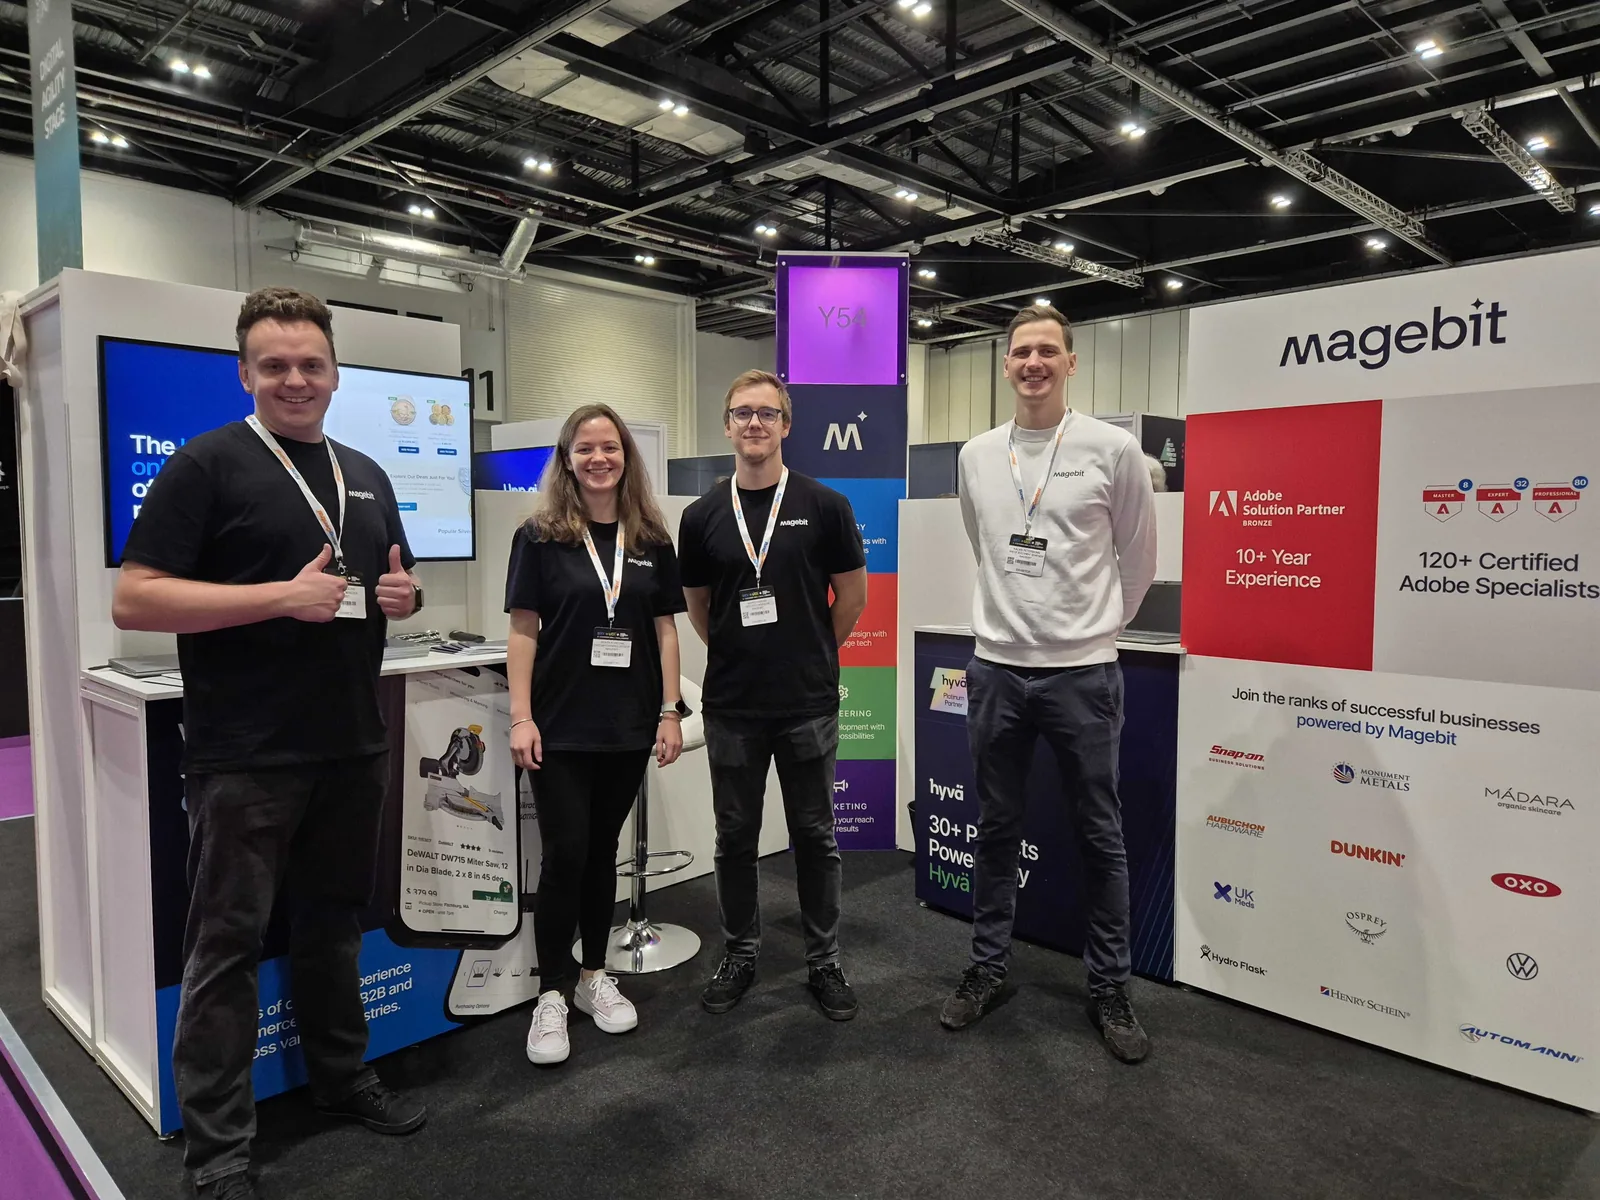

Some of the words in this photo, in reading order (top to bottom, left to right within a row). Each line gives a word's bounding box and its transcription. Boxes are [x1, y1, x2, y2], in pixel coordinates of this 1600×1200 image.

[42, 67, 65, 112] AGILITY
[44, 102, 65, 139] STAGE
[818, 306, 868, 329] Y54
[129, 434, 176, 456] The
[1243, 490, 1283, 502] Adobe
[1243, 504, 1293, 516] Solution
[1297, 504, 1345, 515] Partner
[1236, 548, 1267, 564] 10+
[1271, 549, 1312, 565] Year
[1419, 551, 1472, 569] 120+
[1479, 552, 1579, 572] Certified
[1225, 569, 1322, 589] Experience
[1399, 575, 1469, 594] Adobe
[1475, 577, 1600, 599] Specialists
[856, 639, 872, 647] tech
[872, 630, 888, 638] with
[942, 674, 967, 690] hyvä
[943, 692, 965, 701] Platinum
[944, 700, 964, 708] Partner
[838, 709, 872, 717] EERING
[1232, 687, 1260, 702] Join
[1262, 691, 1286, 705] the
[1288, 696, 1328, 710] ranks
[1331, 699, 1348, 712] of
[1350, 702, 1435, 723] successful
[1440, 710, 1541, 734] businesses
[838, 732, 875, 740] ossibilities
[870, 723, 885, 731] with
[1297, 715, 1361, 733] powered
[1365, 721, 1385, 739] by
[1388, 724, 1457, 745] Magebit
[1209, 744, 1265, 762] Snap-on
[1209, 757, 1234, 765] BUSINESS
[1235, 761, 1265, 771] SOLUTIONS
[1360, 768, 1410, 781] MONUMENT
[929, 778, 964, 801] hyvä
[1360, 777, 1410, 792] METALS
[833, 802, 868, 810] KETING
[1485, 787, 1575, 810] MÁDARA
[1497, 801, 1527, 810] organic
[1528, 805, 1562, 816] skincare
[836, 825, 859, 833] results
[854, 816, 875, 824] reach
[929, 814, 961, 837] 30+
[1206, 814, 1265, 832] AUBUCHON
[1206, 821, 1264, 839] HARDWARE
[407, 848, 439, 860] DeWALT
[441, 853, 466, 864] DW715
[467, 857, 484, 867] Miter
[485, 859, 501, 869] Saw,
[501, 862, 509, 870] 12
[929, 838, 974, 868] Powe
[406, 864, 414, 872] in
[416, 864, 429, 873] Dia
[431, 866, 454, 877] Blade,
[455, 870, 461, 878] 2
[467, 871, 473, 879] 8
[481, 873, 491, 881] 45
[929, 862, 970, 893] Hyvä
[1234, 886, 1255, 902] UK
[1504, 877, 1548, 894] OXO
[1234, 898, 1255, 909] Meds
[1346, 911, 1387, 928] OSPREY
[1211, 952, 1239, 968] Hydro
[1240, 961, 1266, 976] Flask
[388, 977, 413, 996] and
[1330, 988, 1366, 1007] HENRY
[266, 999, 283, 1017] of
[364, 1001, 402, 1022] stries.
[1460, 1027, 1578, 1063] AUTOMANN
